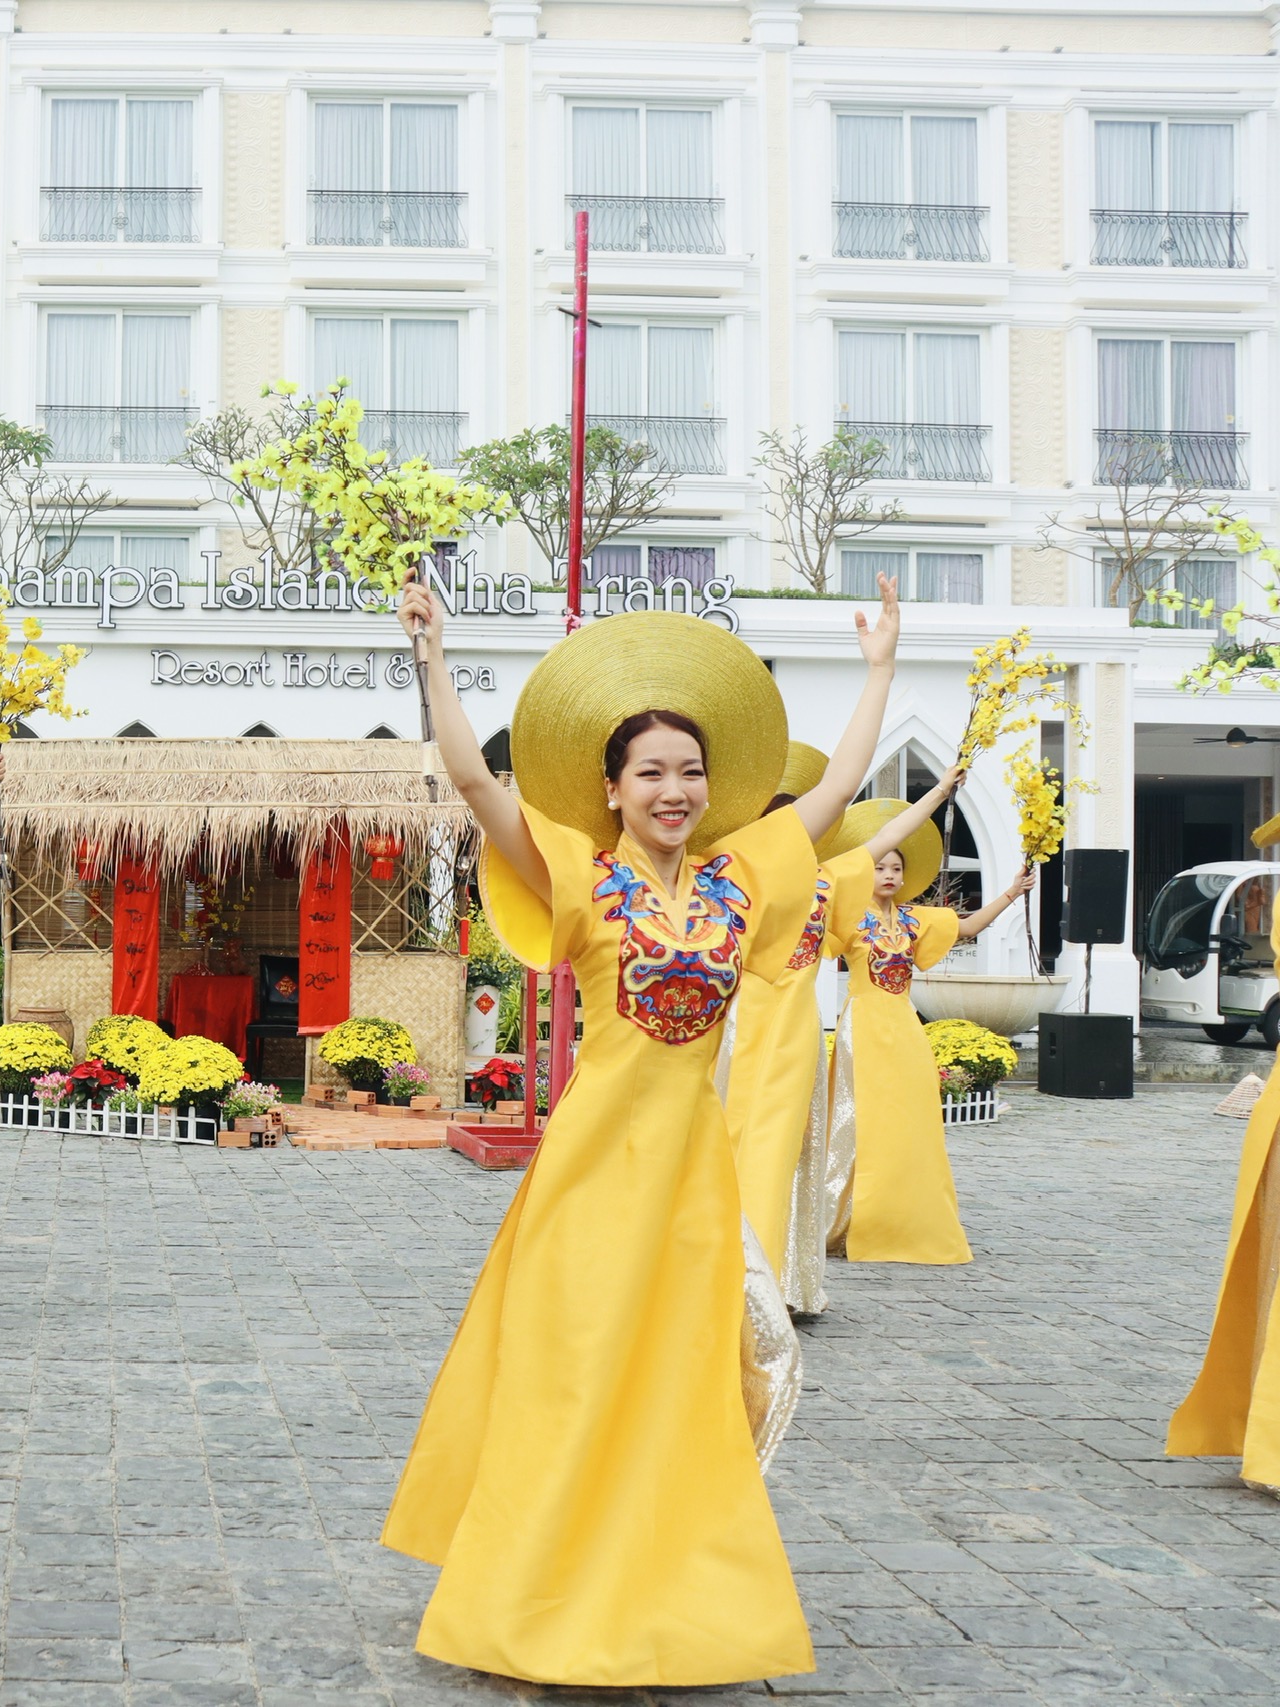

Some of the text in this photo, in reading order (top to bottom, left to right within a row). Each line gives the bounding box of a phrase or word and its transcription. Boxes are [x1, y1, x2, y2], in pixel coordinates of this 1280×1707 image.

[423, 549, 537, 615] Nha
[151, 650, 496, 701] Resort Hotel & pa
